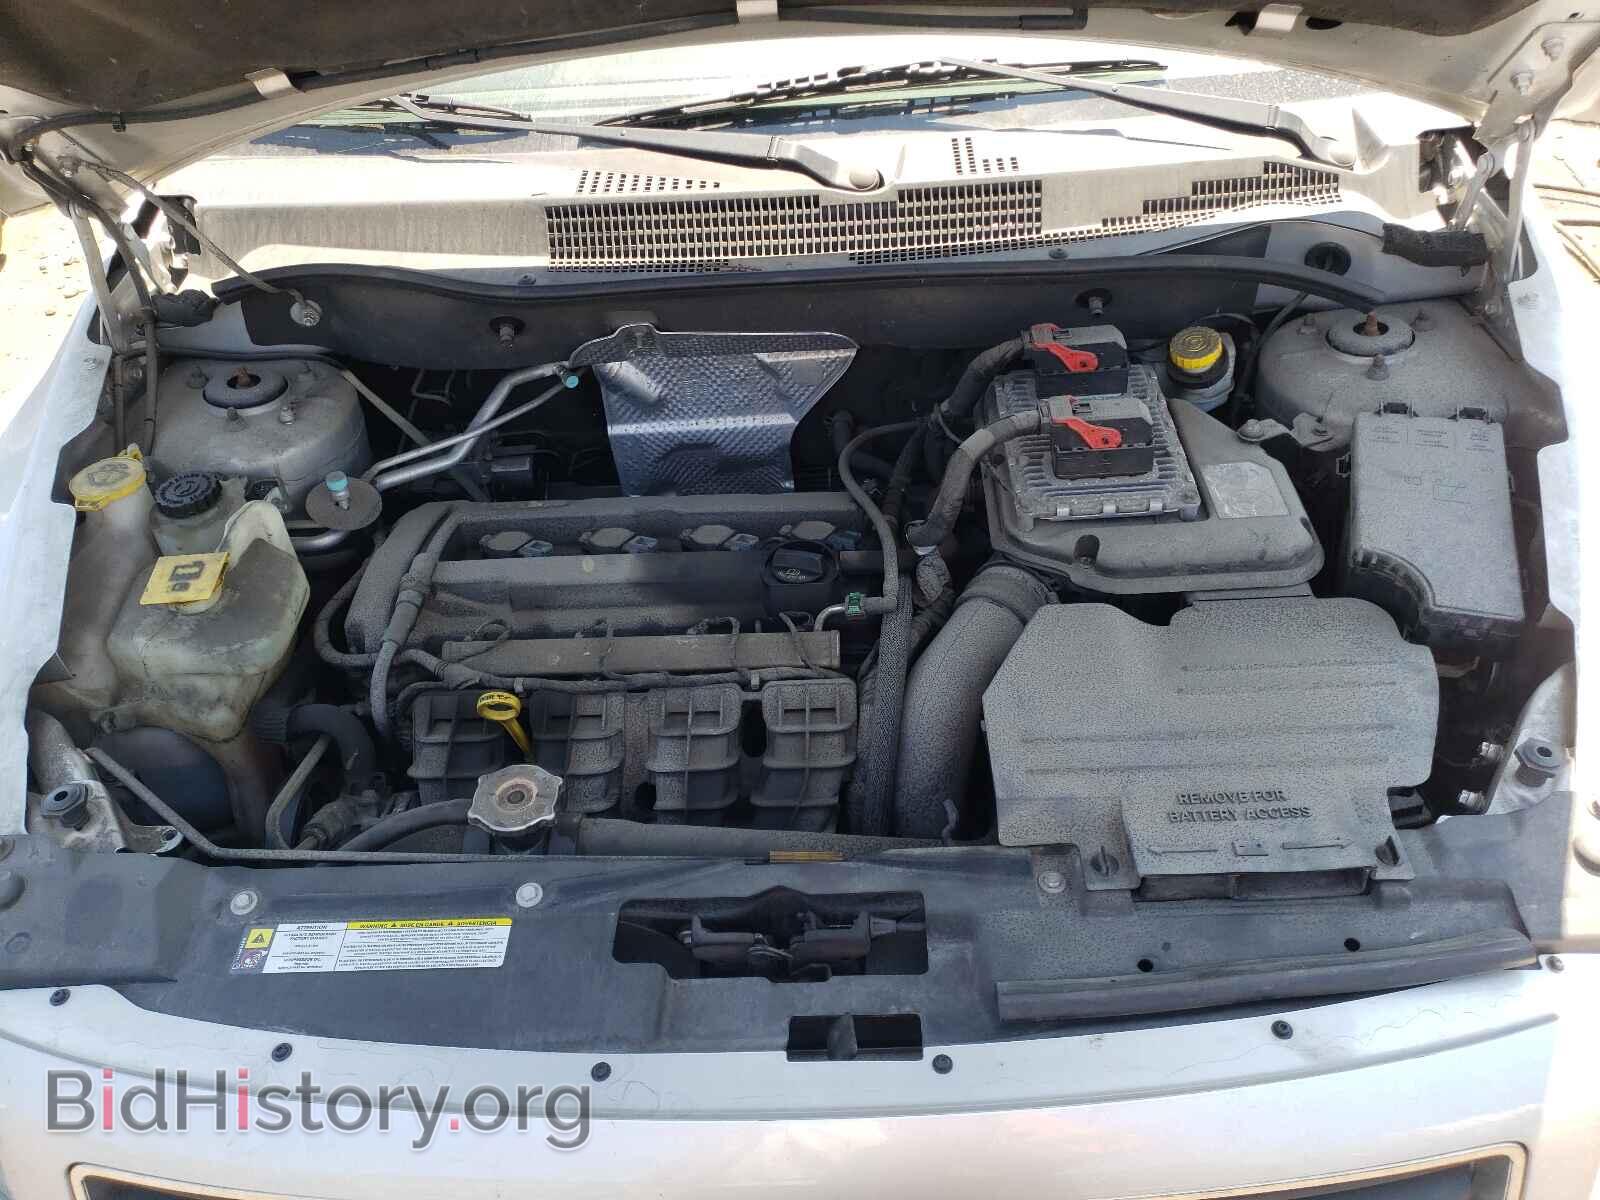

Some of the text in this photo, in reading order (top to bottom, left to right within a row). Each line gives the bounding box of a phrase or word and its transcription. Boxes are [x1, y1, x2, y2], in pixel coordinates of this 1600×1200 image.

[1177, 790, 1287, 805] REMOVE FOR
[1168, 806, 1312, 823] BATTERY ACCESS
